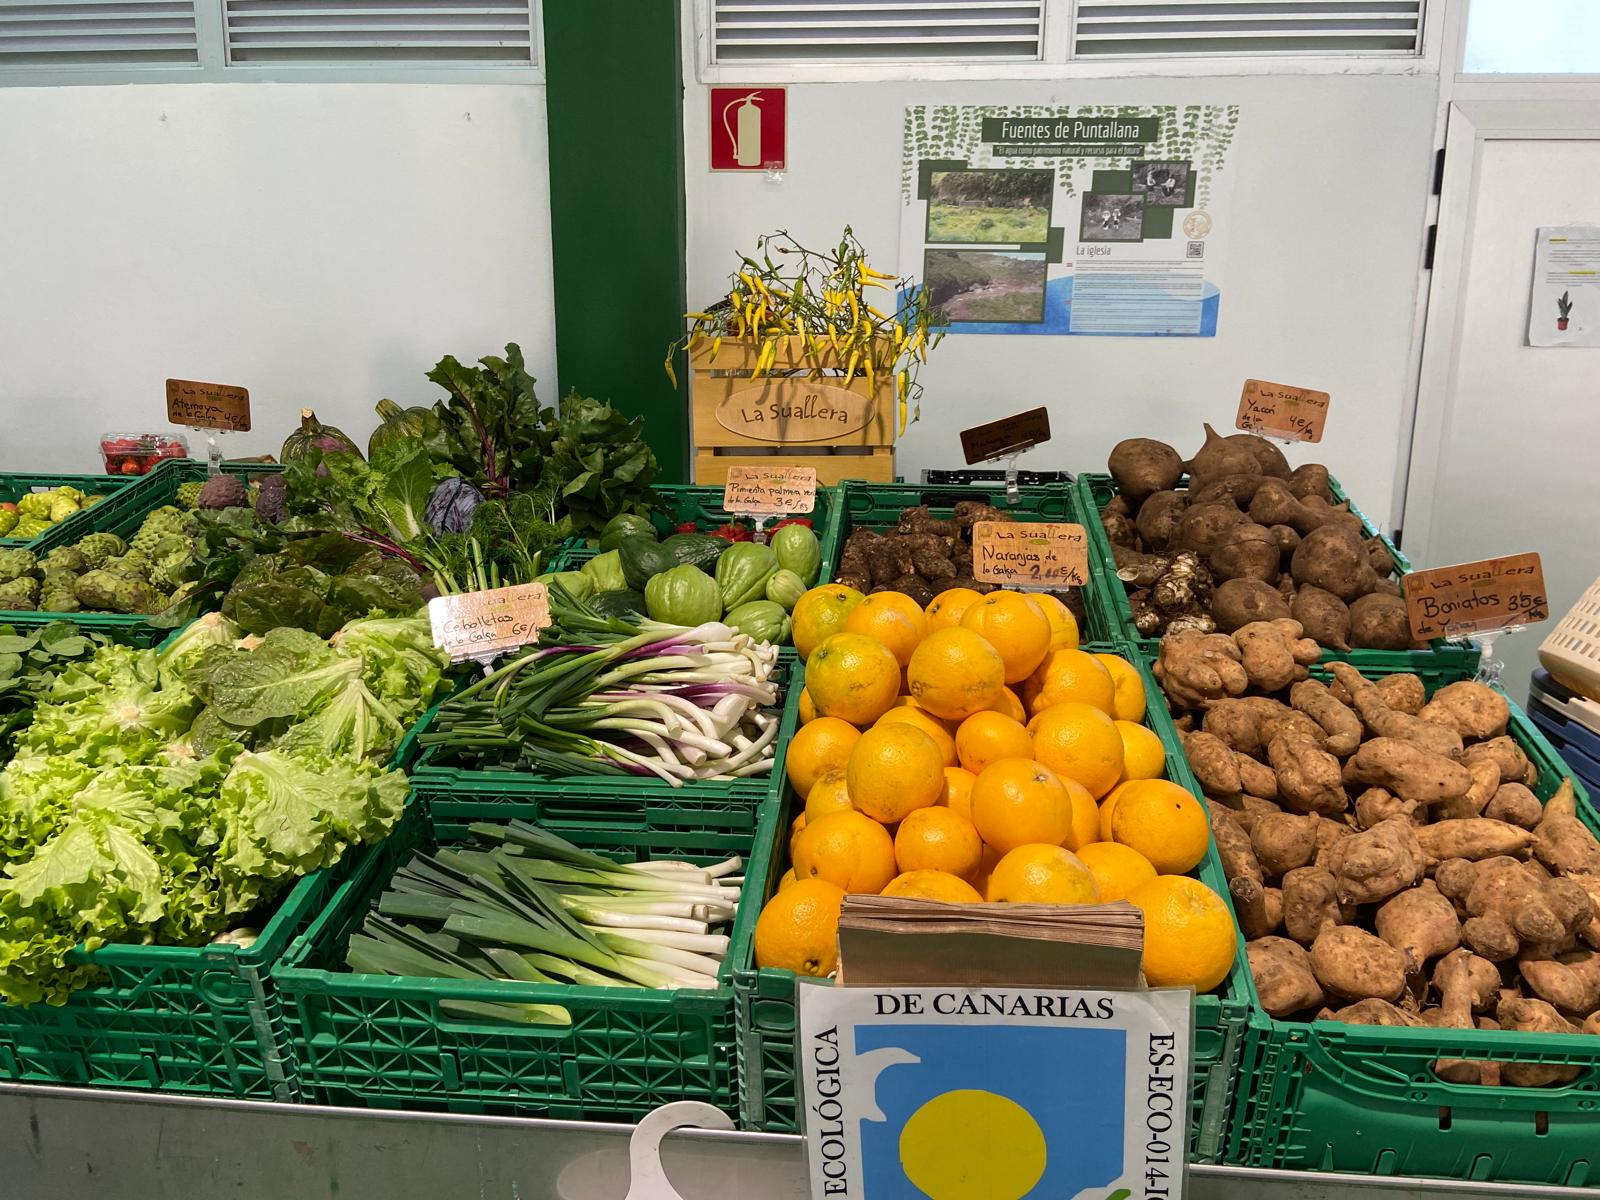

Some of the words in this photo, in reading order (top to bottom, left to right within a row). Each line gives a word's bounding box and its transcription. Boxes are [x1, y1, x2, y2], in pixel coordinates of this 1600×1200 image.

[1002, 122, 1050, 138] Fuentes
[1054, 122, 1070, 138] de
[1074, 122, 1140, 138] Puntallana
[1076, 246, 1084, 256] La
[1087, 246, 1111, 257] iglesia
[742, 408, 764, 423] La
[770, 395, 848, 424] Suallera
[1242, 412, 1250, 420] de
[1248, 398, 1275, 415] Yacón
[729, 482, 766, 494] Pimienta
[1020, 528, 1081, 542] Suallera
[982, 545, 1040, 566] Naranjas
[1046, 550, 1057, 561] de
[1430, 580, 1452, 589] La
[1458, 564, 1534, 583] Suallera
[1417, 590, 1500, 618] Boniatos
[1418, 622, 1433, 634] de
[874, 994, 924, 1015] DE
[932, 994, 1114, 1020] CANARIAS
[814, 1025, 847, 1197] ECOLÓGICA
[1145, 1032, 1174, 1200] ES-ECO-014-I
